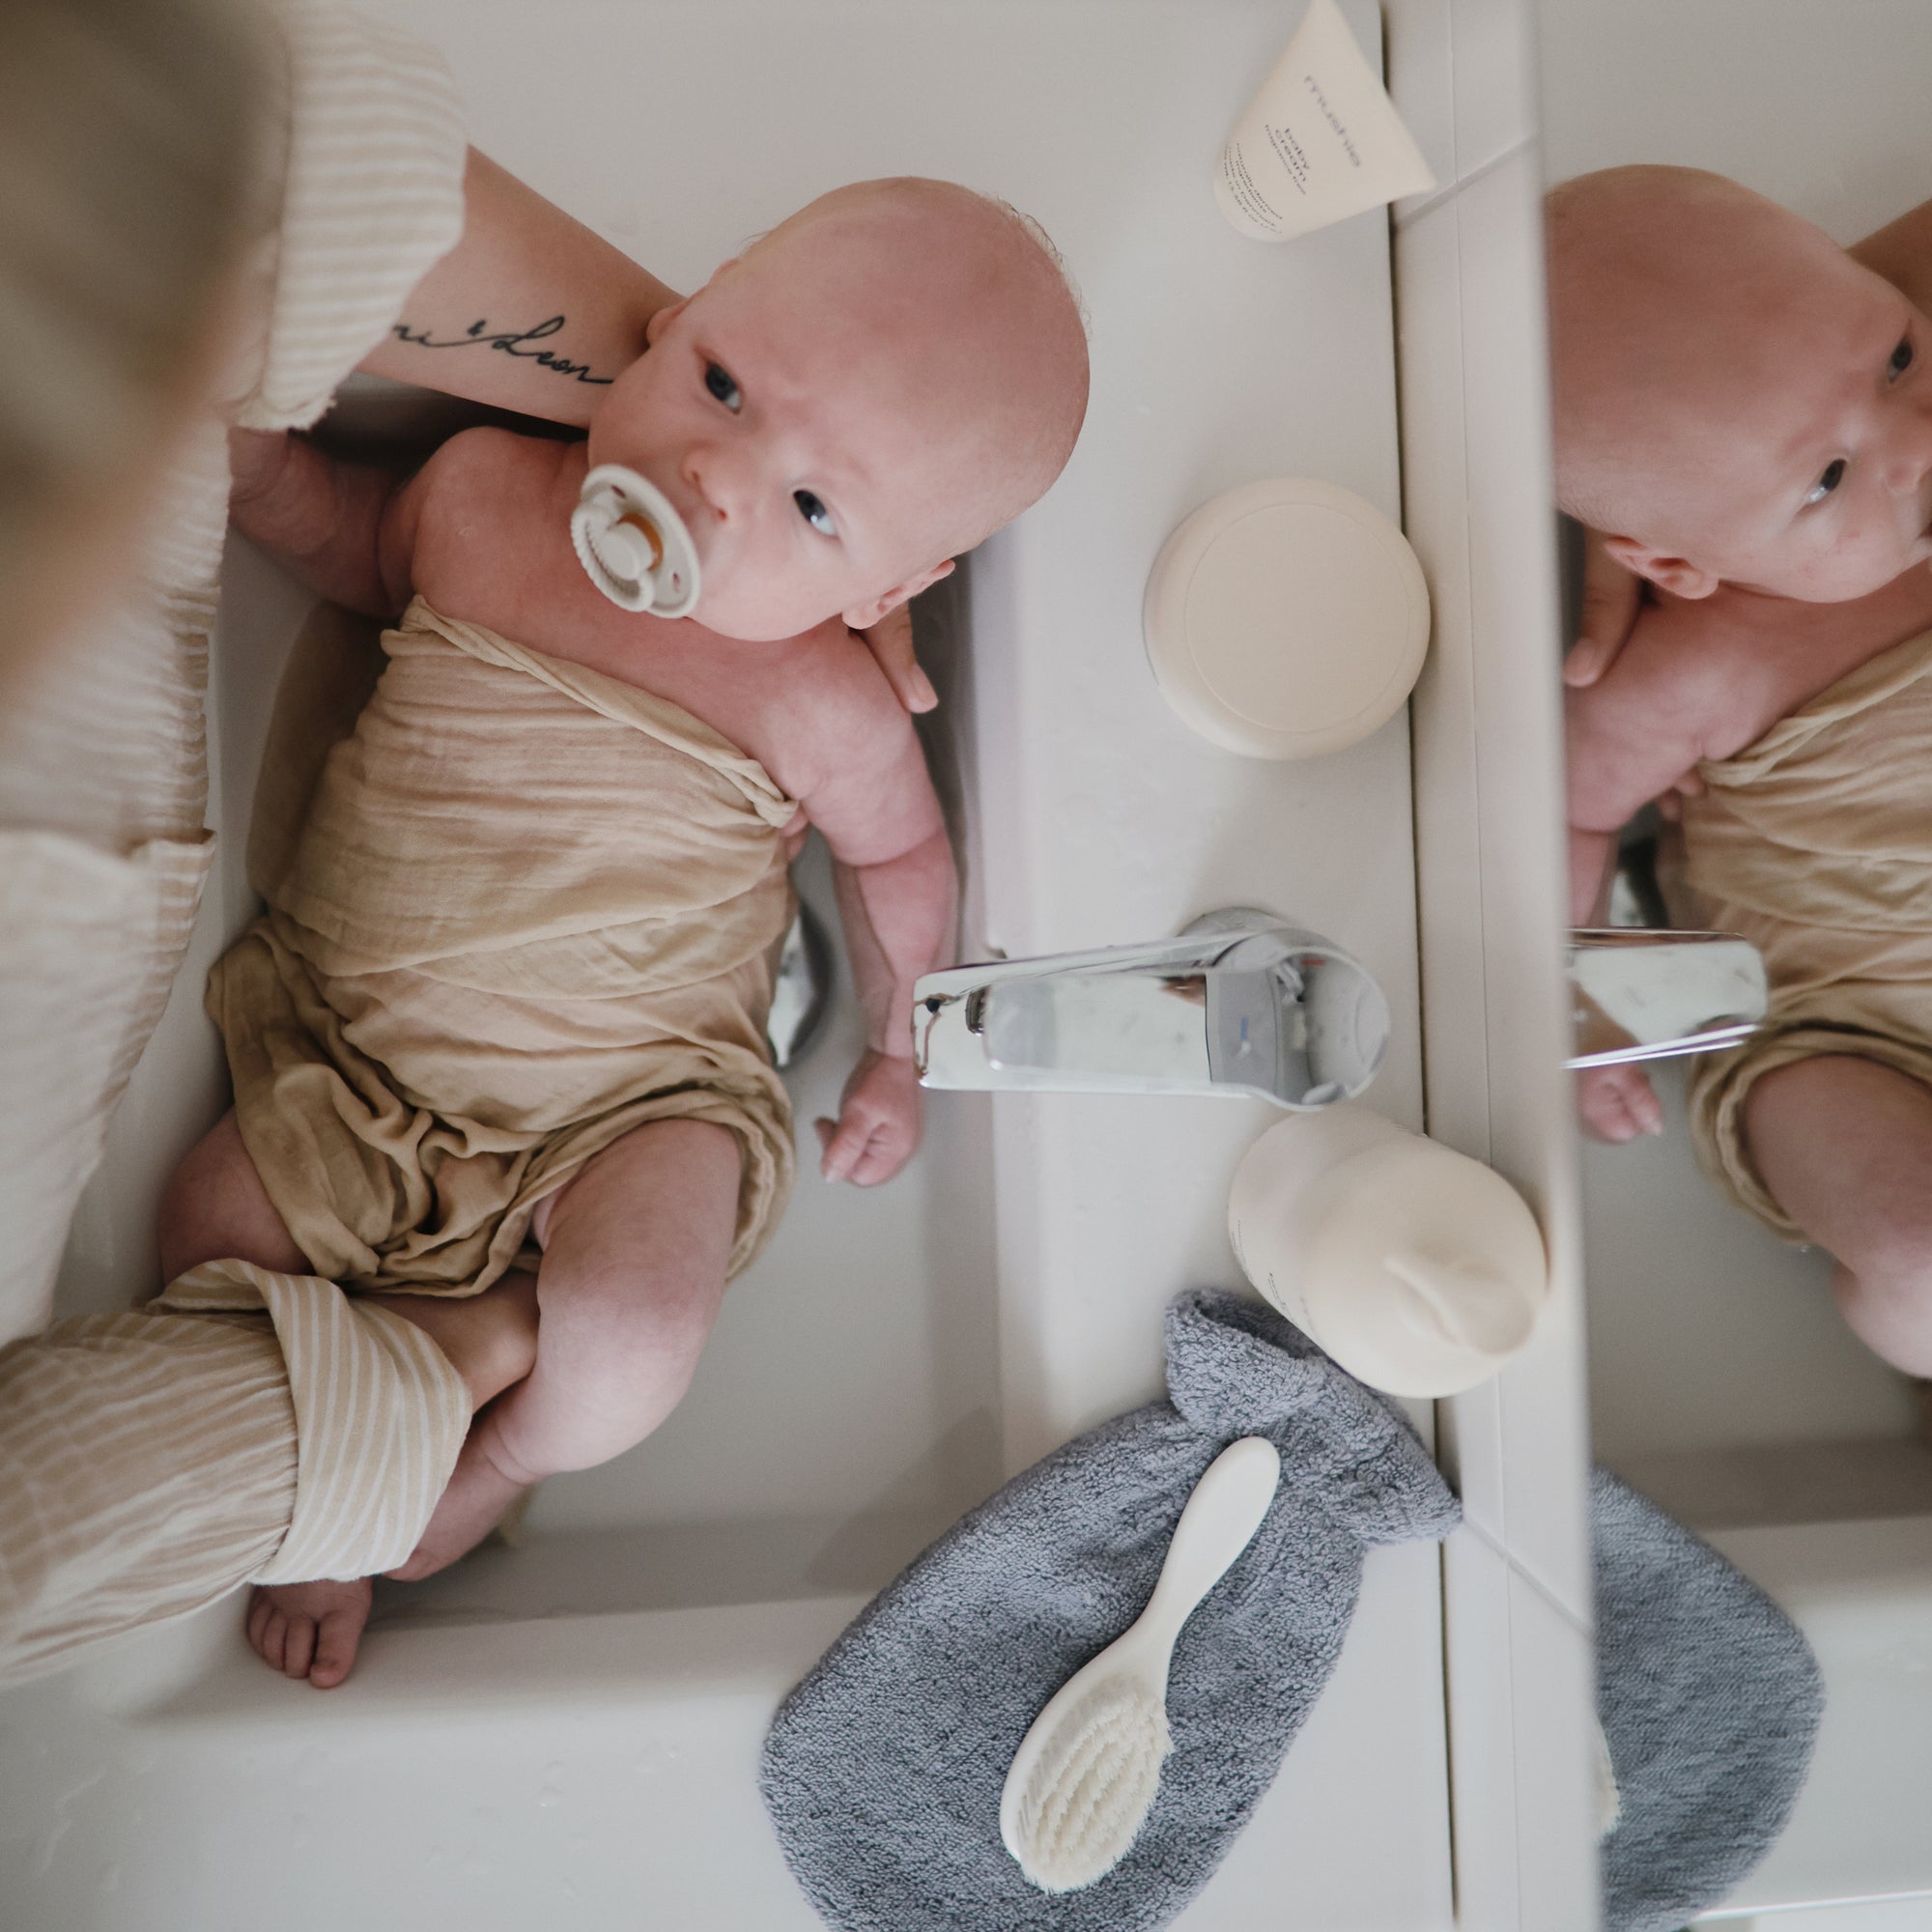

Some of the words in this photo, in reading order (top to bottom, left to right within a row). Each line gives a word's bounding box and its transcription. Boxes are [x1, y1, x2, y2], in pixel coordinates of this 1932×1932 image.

[1304, 75, 1360, 167] mushie
[1264, 124, 1293, 175] fragrance
[1292, 175, 1307, 195] free
[1275, 129, 1306, 182] cream
[1285, 128, 1310, 170] baby
[1235, 159, 1267, 213] ingredients
[1236, 142, 1254, 187] naturally
[1254, 188, 1283, 220] derived
[1239, 190, 1276, 227] Denmark
